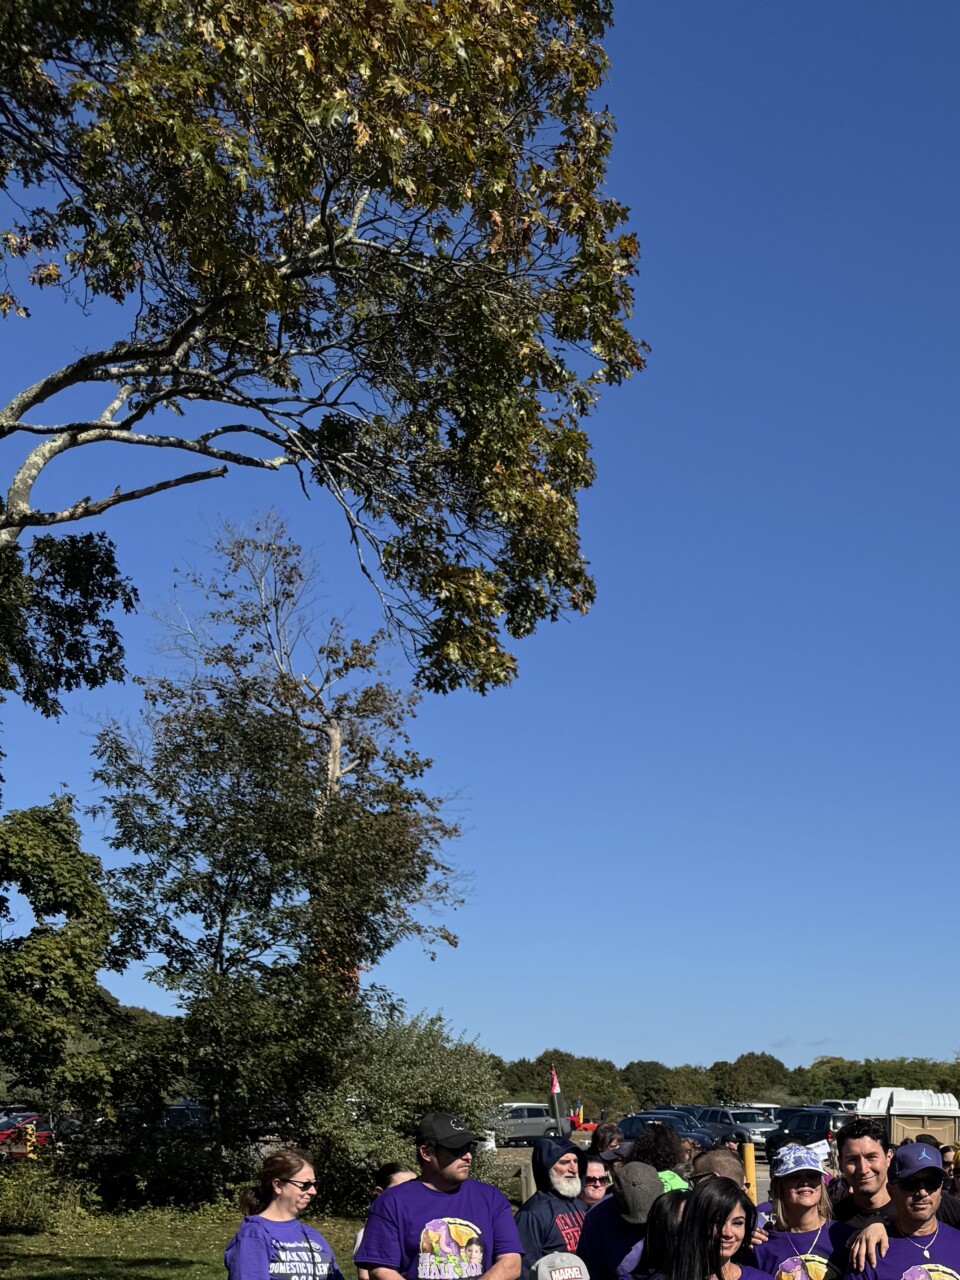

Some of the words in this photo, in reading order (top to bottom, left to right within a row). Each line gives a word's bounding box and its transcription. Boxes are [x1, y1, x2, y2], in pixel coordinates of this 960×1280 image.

[269, 1262, 306, 1274] DOMESTIC
[305, 1263, 335, 1275] VILENCE
[418, 1262, 460, 1279] WALK
